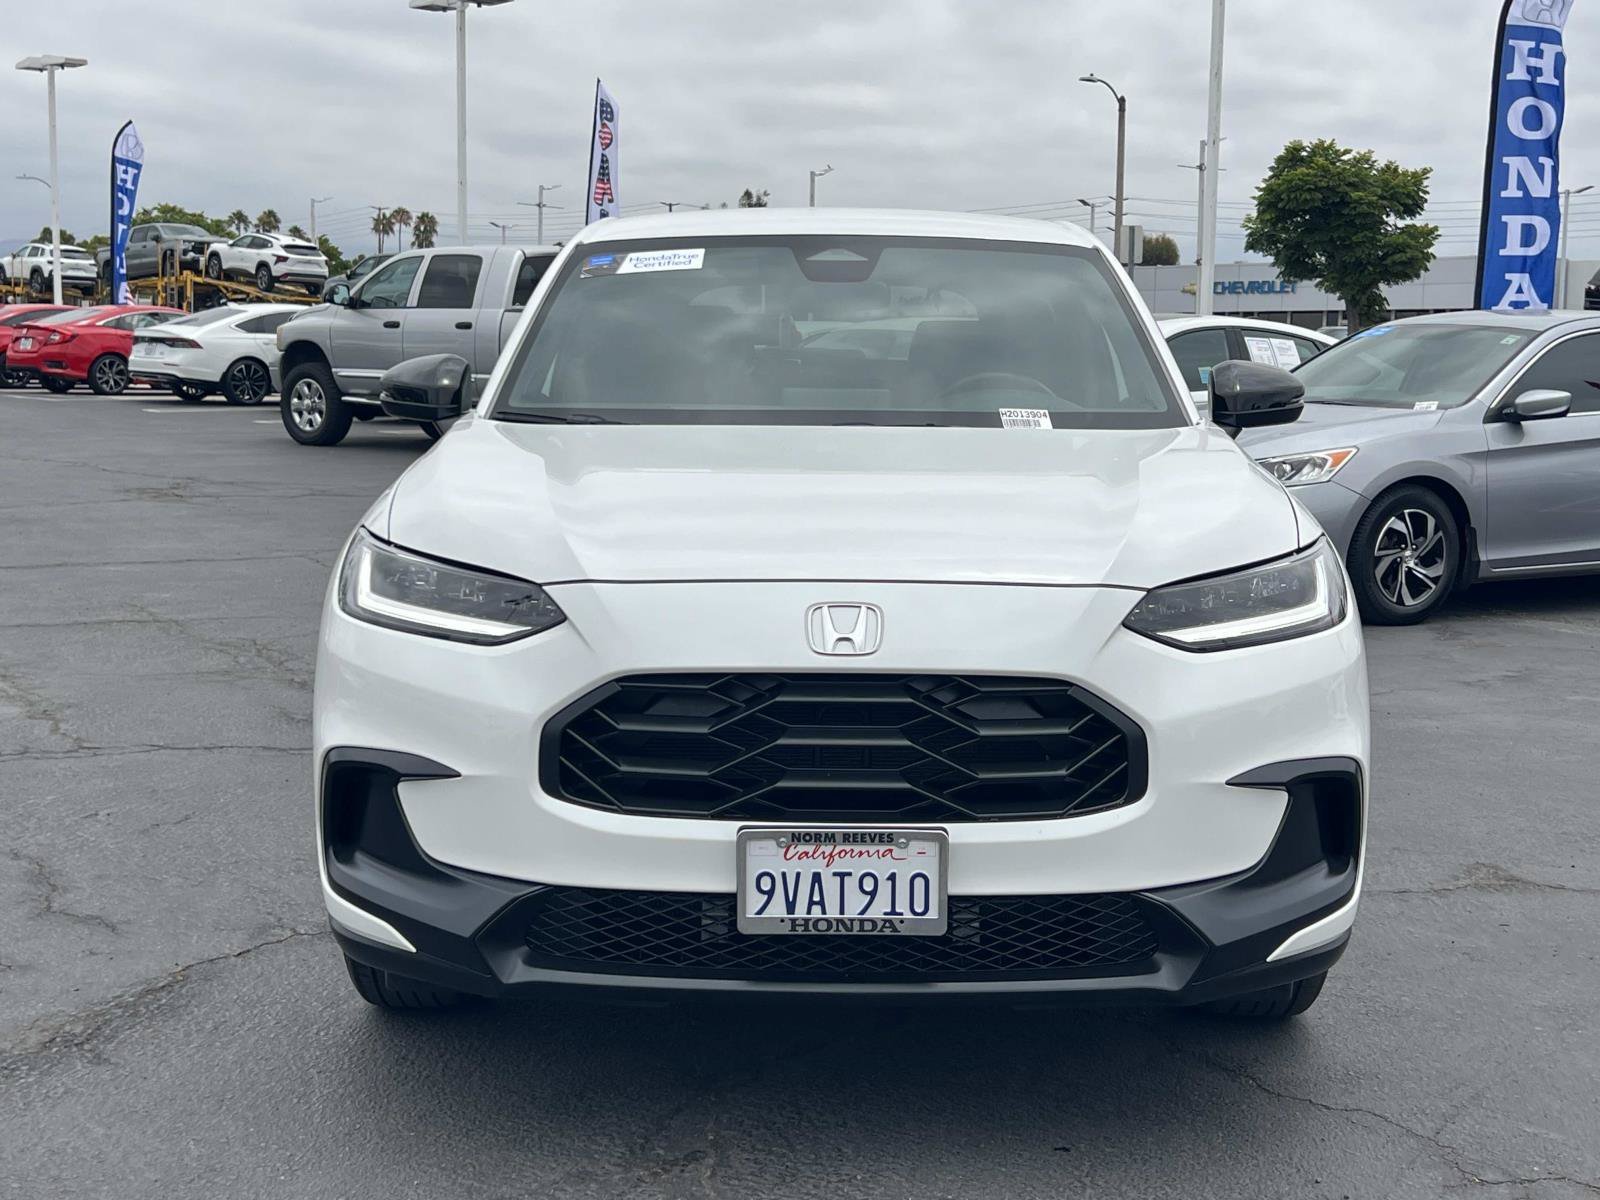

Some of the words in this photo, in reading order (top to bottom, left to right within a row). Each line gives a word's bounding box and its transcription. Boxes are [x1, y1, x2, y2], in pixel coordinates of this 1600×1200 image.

[1491, 39, 1561, 311] HONDA
[629, 252, 700, 264] HondaTrue
[633, 259, 693, 269] Certified
[1213, 280, 1299, 295] CHEVROLET
[791, 832, 836, 843] NORM
[842, 832, 894, 843] REEVES
[783, 842, 907, 867] California
[754, 871, 930, 917] 9VAT910
[788, 917, 901, 933] HONDA
